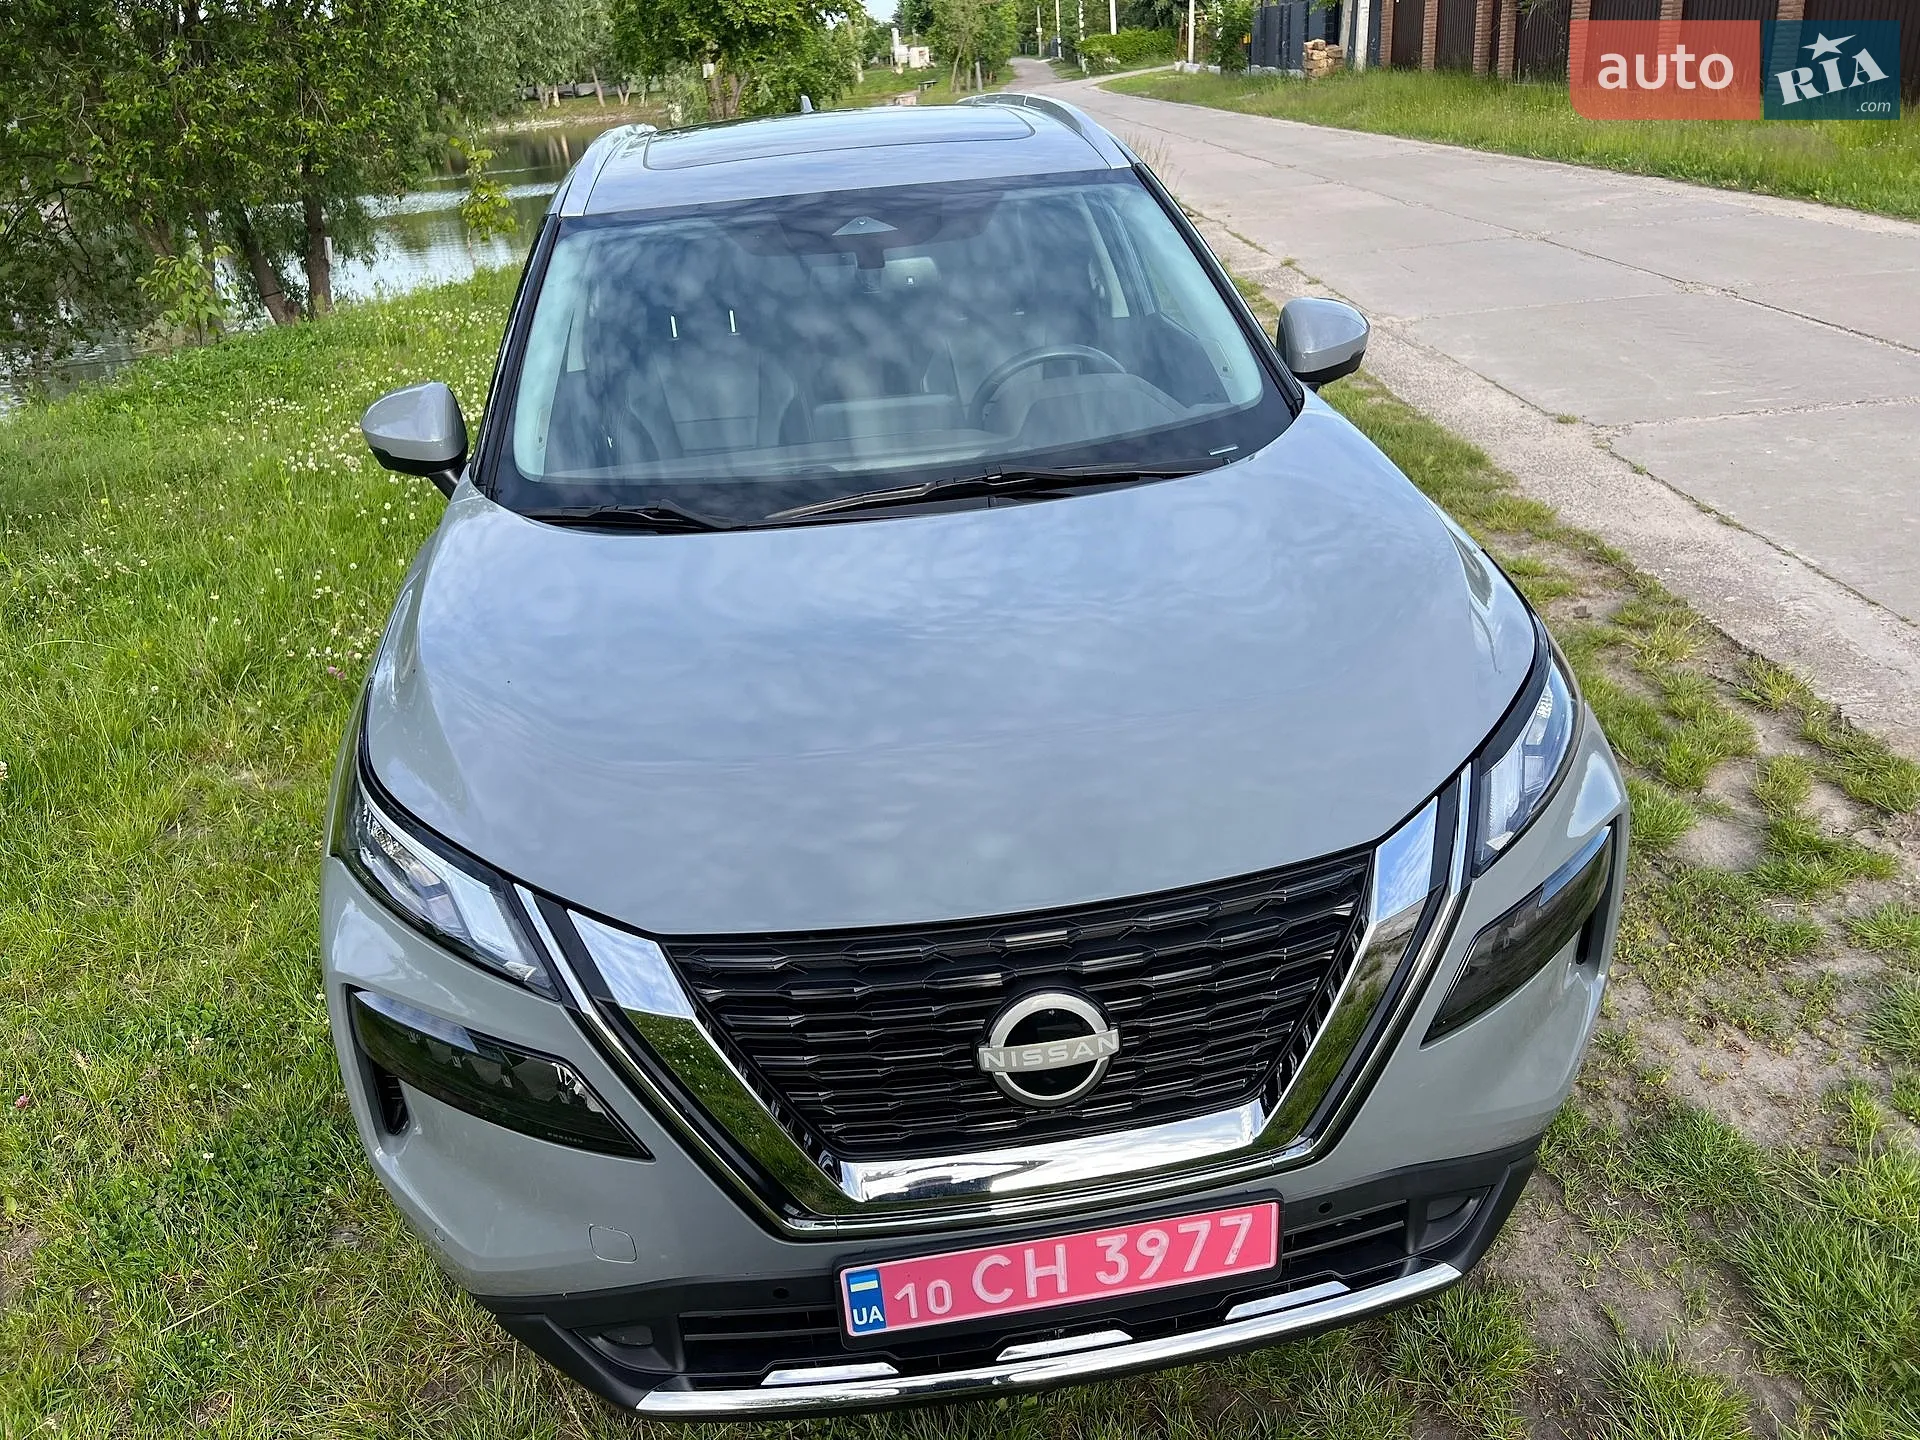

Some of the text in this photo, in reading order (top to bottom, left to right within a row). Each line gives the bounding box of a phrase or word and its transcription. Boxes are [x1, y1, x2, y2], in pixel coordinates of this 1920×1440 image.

[983, 1033, 1119, 1068] NISSAN
[894, 1213, 1253, 1319] 10 CH 3977
[852, 1303, 884, 1326] UA
